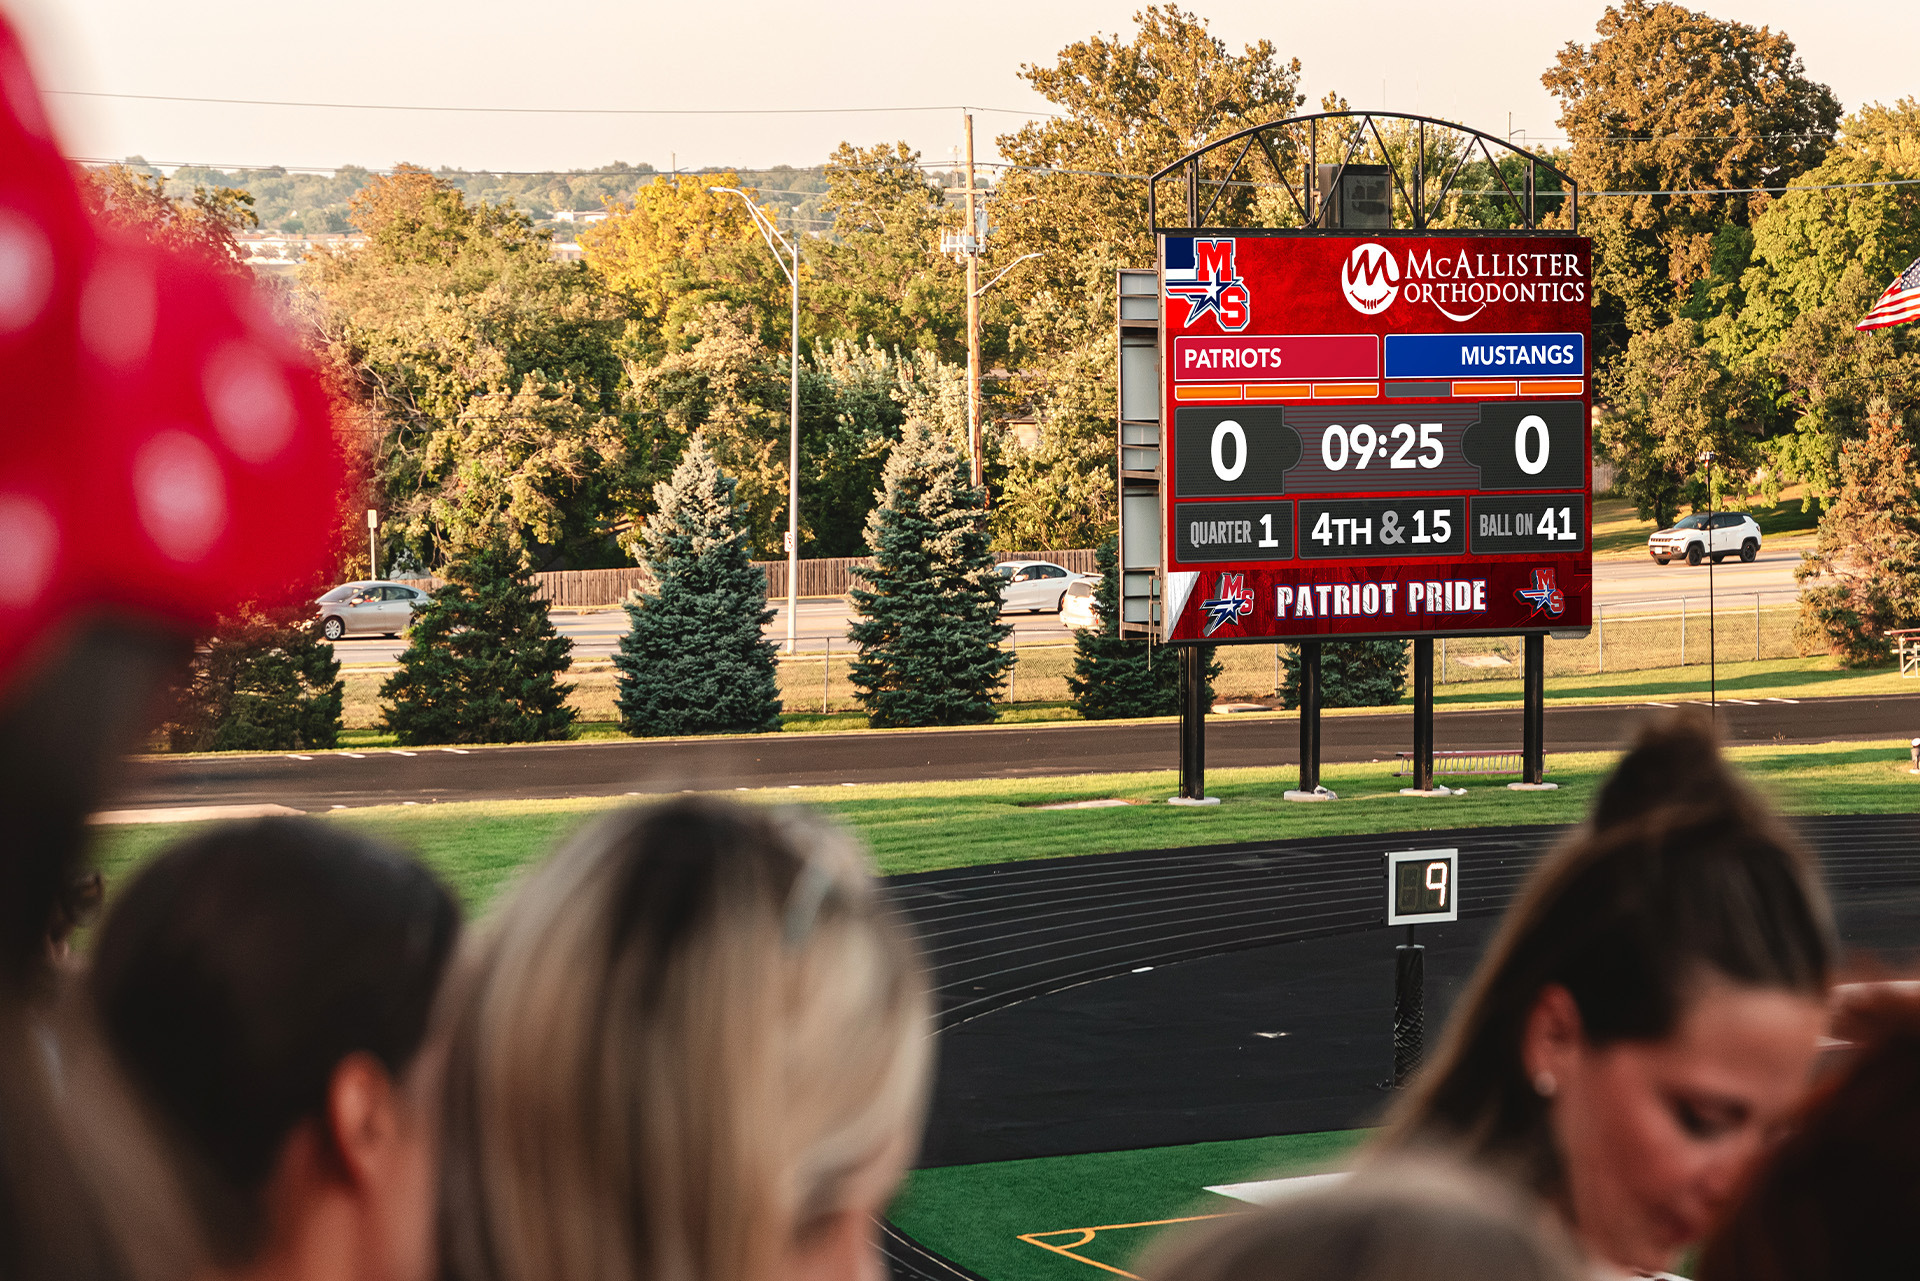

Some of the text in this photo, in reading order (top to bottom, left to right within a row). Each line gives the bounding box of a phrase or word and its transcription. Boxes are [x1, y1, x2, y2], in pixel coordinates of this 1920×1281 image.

[1404, 282, 1585, 307] ORTHODONTICS
[1184, 347, 1282, 369] PATRIOTS
[1461, 345, 1574, 366] MUSTANGS
[1210, 420, 1248, 482] 0
[1321, 423, 1444, 471] 09:25
[1514, 415, 1550, 475] 0
[1190, 513, 1279, 548] QUARTER 1
[1311, 509, 1452, 546] 4TH & 15
[1479, 507, 1577, 541] BALL ON 41
[1276, 580, 1487, 618] PATRIOT PRIDE
[1426, 862, 1448, 907] 9
